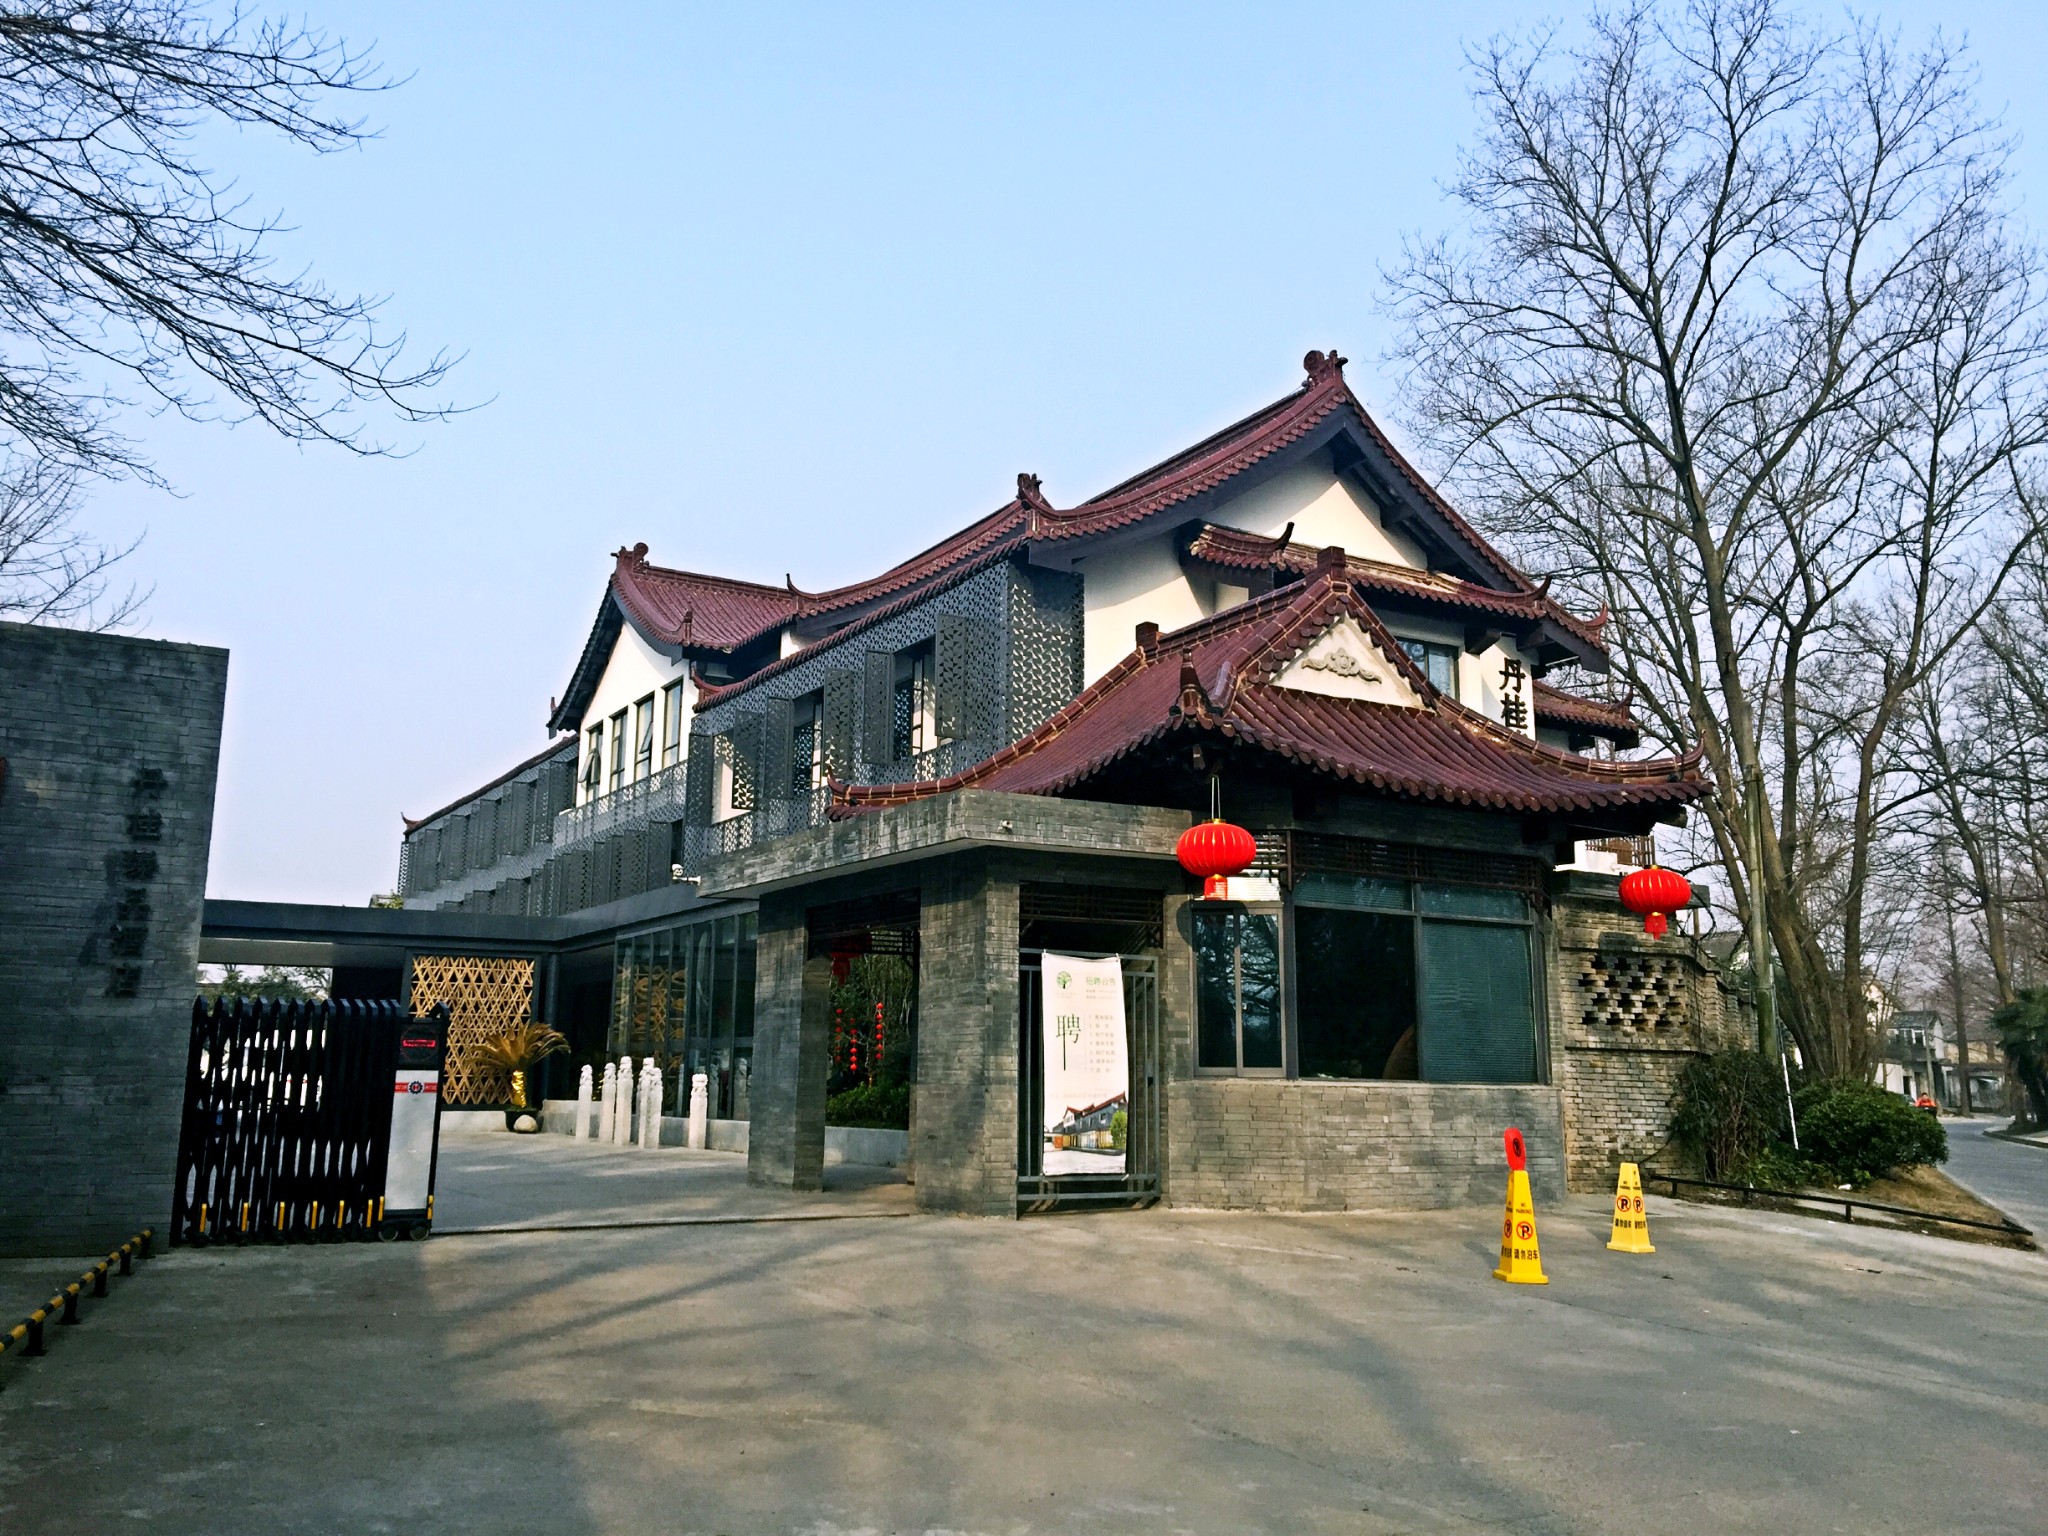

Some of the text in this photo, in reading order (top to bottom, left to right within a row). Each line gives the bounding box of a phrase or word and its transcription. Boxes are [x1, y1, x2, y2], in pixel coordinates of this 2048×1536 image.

[1499, 657, 1528, 738] 丹桂
[1056, 1014, 1082, 1071] 聘
[1514, 1248, 1538, 1260] 请勿泊车
